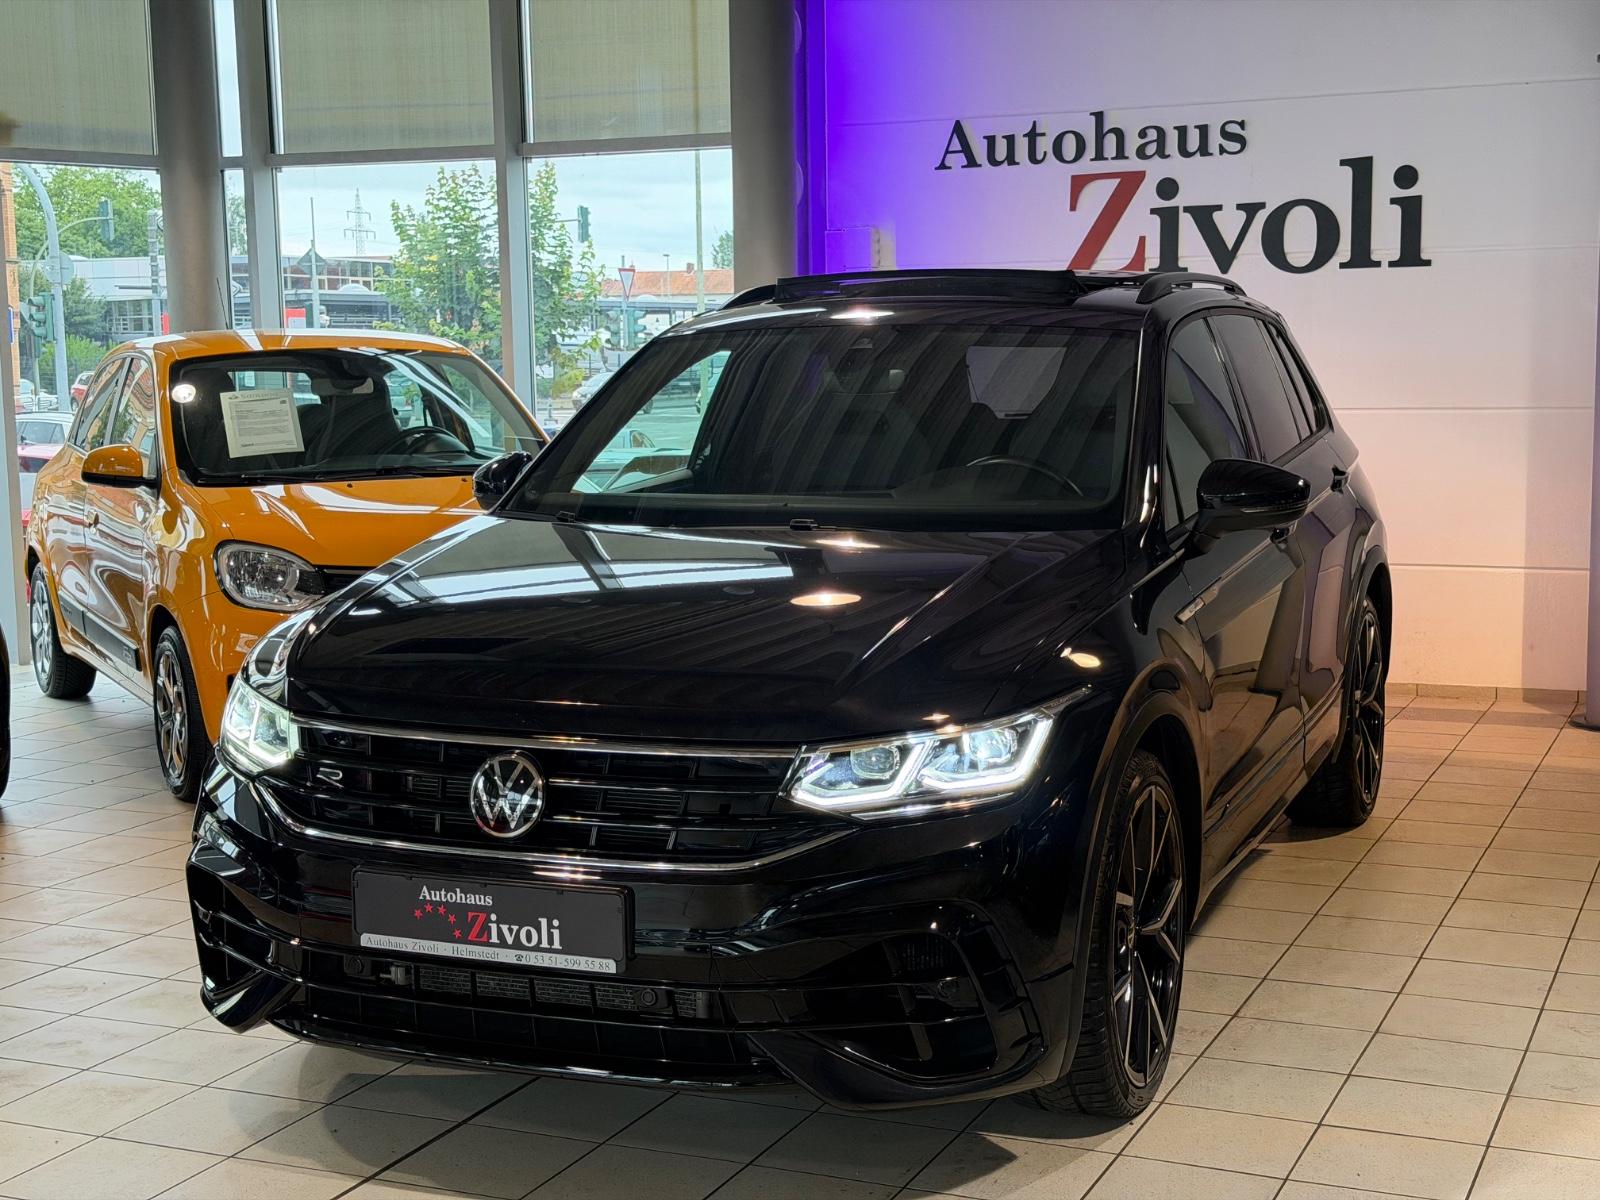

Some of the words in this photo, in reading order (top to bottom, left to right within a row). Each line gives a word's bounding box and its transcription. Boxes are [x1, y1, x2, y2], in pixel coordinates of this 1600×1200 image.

[934, 110, 1248, 171] Autohaus
[1066, 155, 1432, 275] Zivoli
[419, 885, 493, 906] Autohaus
[467, 911, 562, 949] Zivoli
[365, 936, 408, 950] Autohaus
[411, 941, 439, 953] Zivoli
[451, 945, 499, 960] Helmstedt
[534, 955, 545, 964] 53
[584, 959, 596, 969] 55
[598, 960, 610, 971] 88
